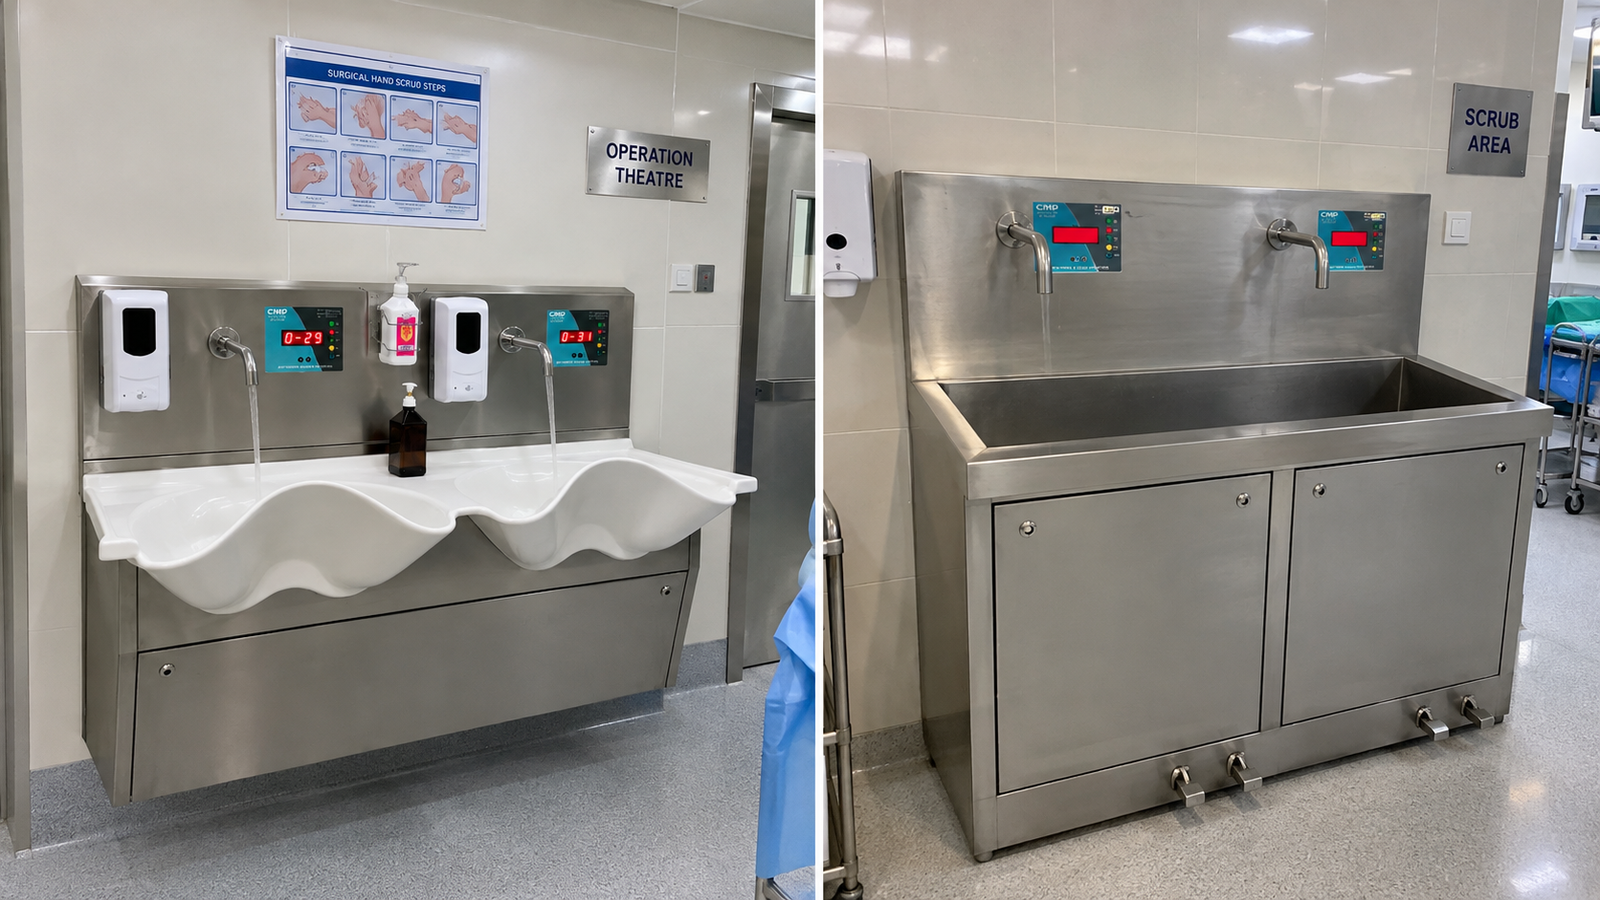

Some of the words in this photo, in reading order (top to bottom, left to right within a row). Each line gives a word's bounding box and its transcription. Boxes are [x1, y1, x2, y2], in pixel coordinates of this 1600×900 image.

[327, 69, 369, 82] SURGICAL
[371, 75, 394, 85] HAND
[423, 82, 447, 93] STEPS
[1465, 107, 1519, 130] SCRUB
[606, 142, 693, 167] OPERATION
[1467, 135, 1511, 154] AREA
[615, 167, 683, 189] THEATRE
